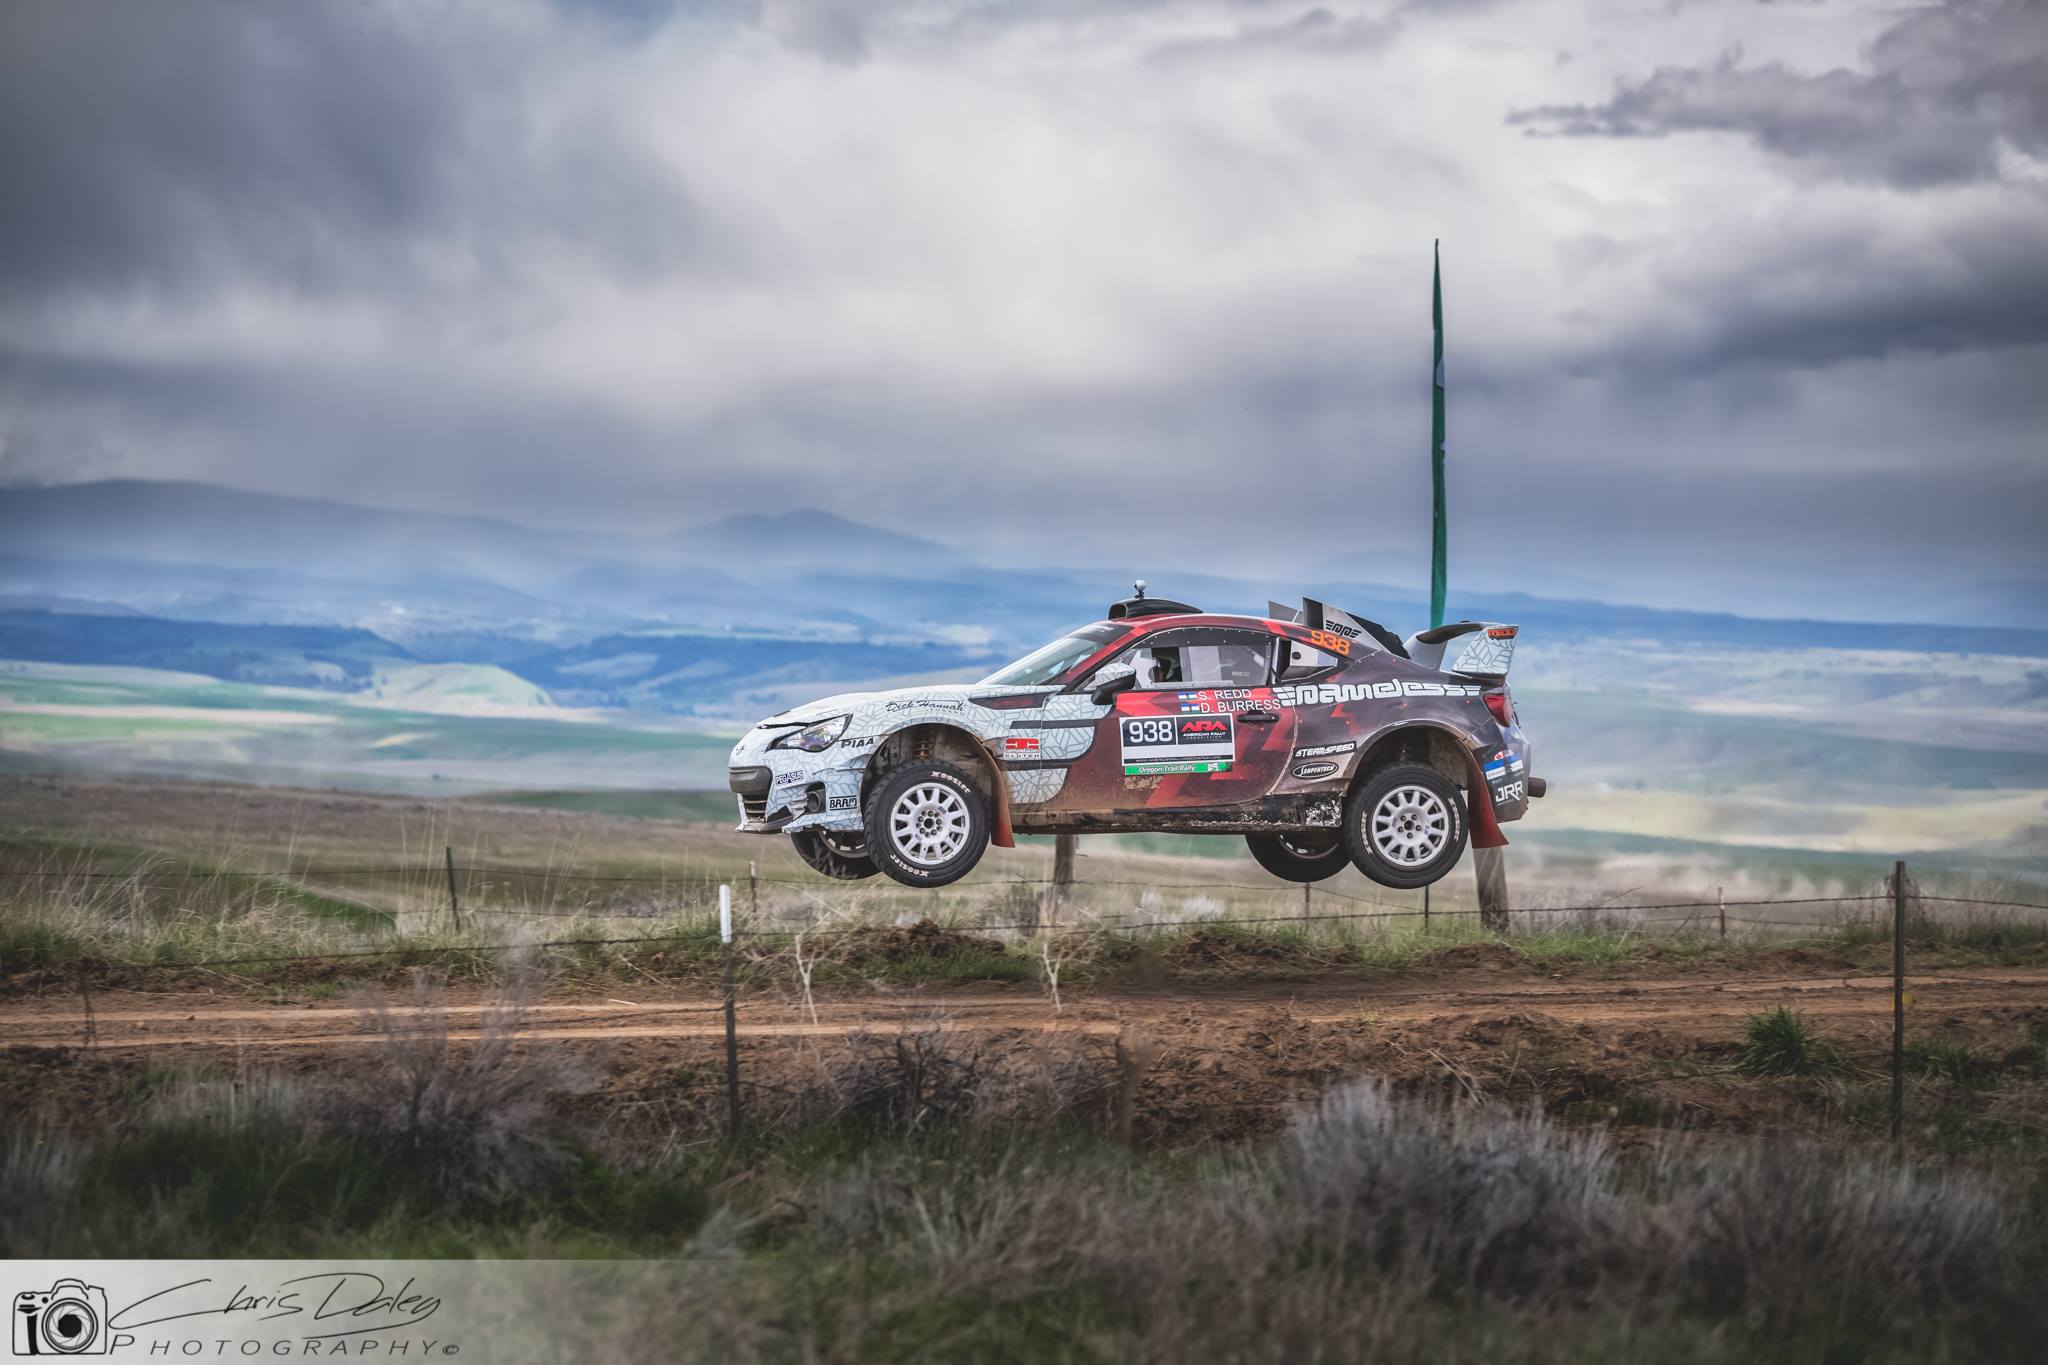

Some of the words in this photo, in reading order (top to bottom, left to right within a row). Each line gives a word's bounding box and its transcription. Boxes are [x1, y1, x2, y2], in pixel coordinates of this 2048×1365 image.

[1311, 629, 1351, 656] 938
[1199, 690, 1212, 701] S.
[1214, 688, 1252, 700] REDD
[885, 701, 914, 713] Dick
[917, 699, 964, 712] Hannah
[1200, 702, 1215, 714] D.
[1217, 699, 1281, 712] BURRESS
[1128, 720, 1173, 743] 938
[1181, 720, 1228, 733] ARA
[840, 738, 875, 749] PIAA
[775, 770, 804, 785] PEGASUS
[1495, 780, 1524, 803] JRR
